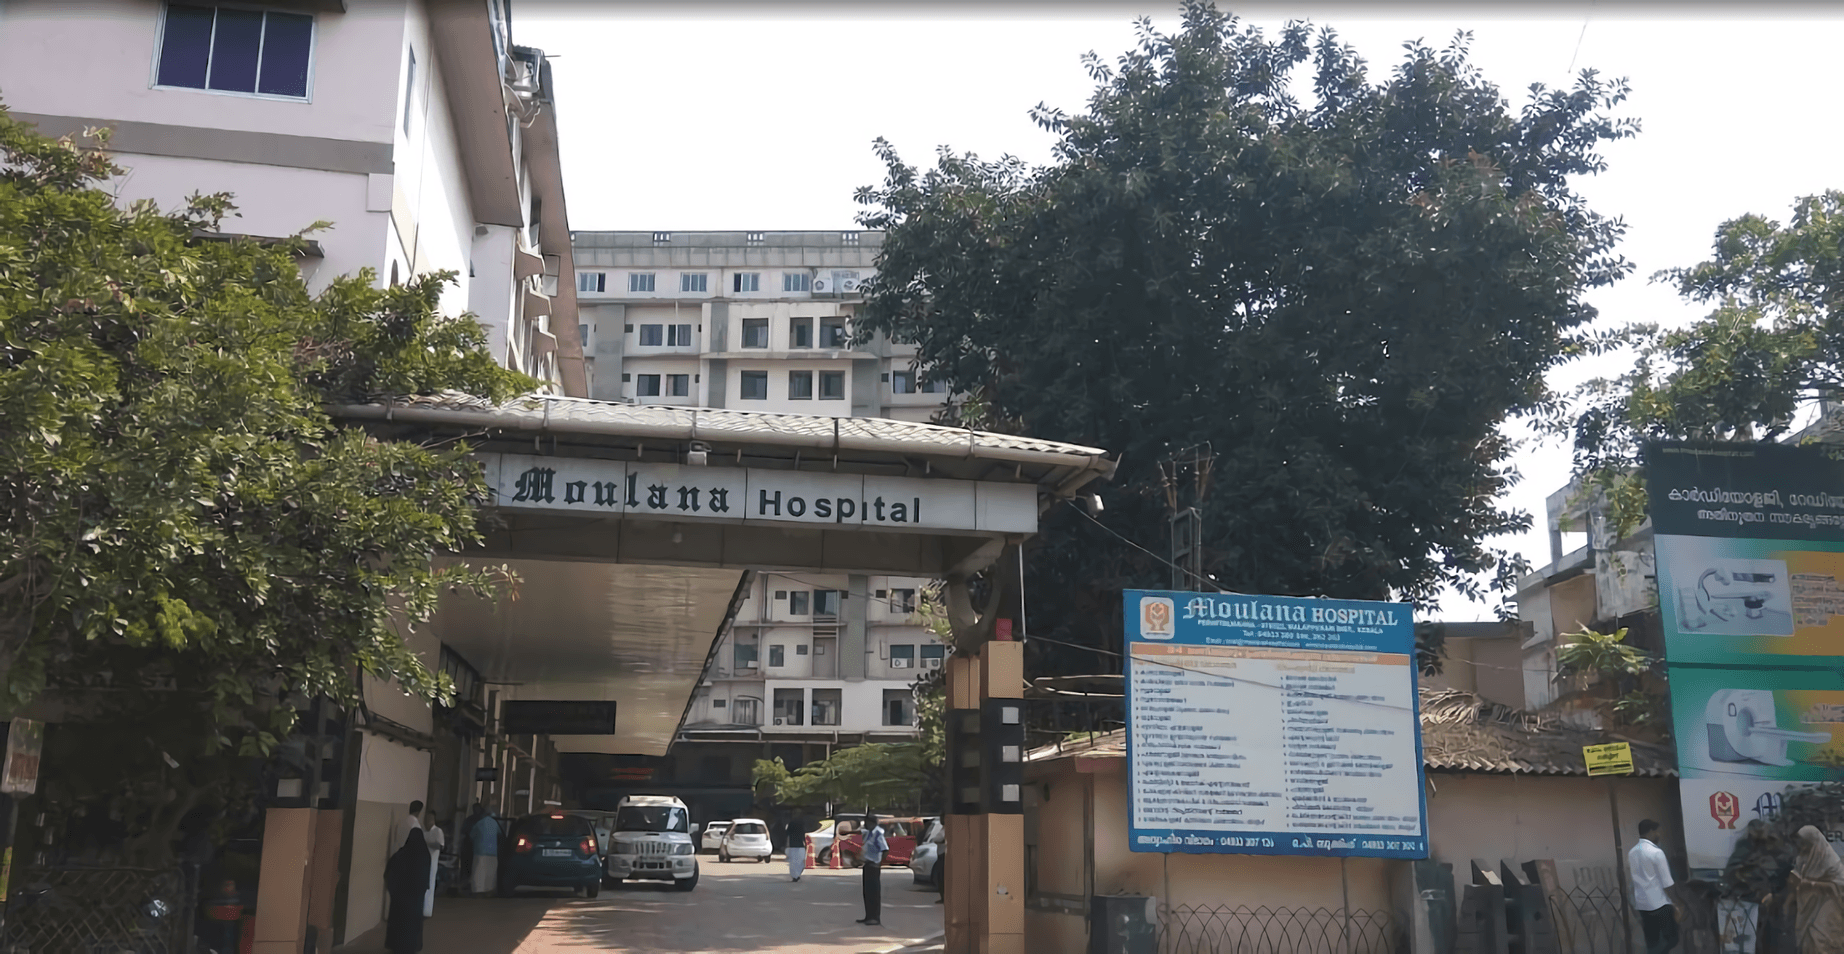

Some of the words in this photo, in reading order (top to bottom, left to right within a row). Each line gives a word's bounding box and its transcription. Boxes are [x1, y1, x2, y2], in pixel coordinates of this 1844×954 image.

[511, 466, 732, 514] Moulana
[758, 488, 922, 524] Hospital
[1182, 597, 1306, 622] Moulana
[1311, 606, 1398, 626] HOSPITAL
